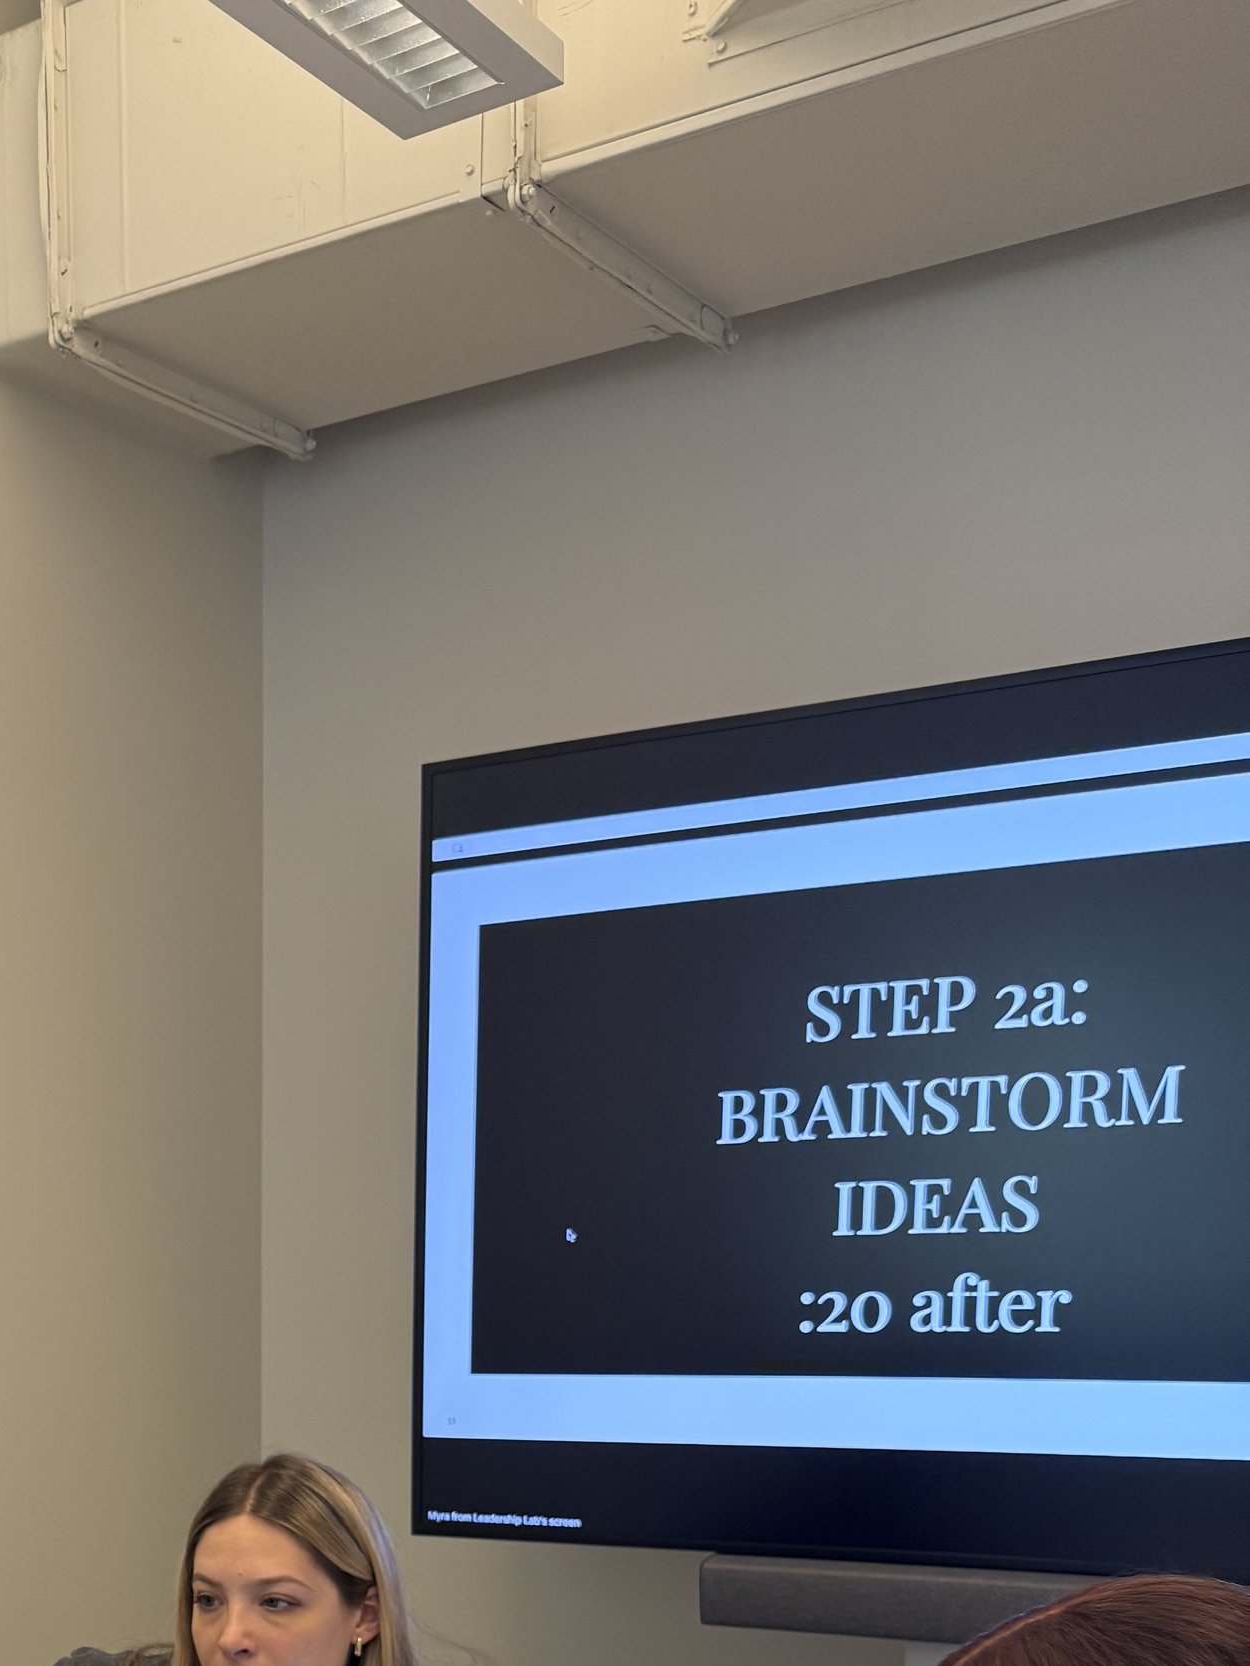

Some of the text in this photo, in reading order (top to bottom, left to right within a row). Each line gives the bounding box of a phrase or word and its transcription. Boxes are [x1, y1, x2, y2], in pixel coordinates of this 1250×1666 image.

[805, 975, 1088, 1044] STEP 2a:
[716, 1065, 1186, 1145] BRAINSTORM
[832, 1174, 1039, 1237] IDEAS
[798, 1272, 1073, 1334] :20 after
[428, 1510, 582, 1528] Myra from Leadership Lab's screen
